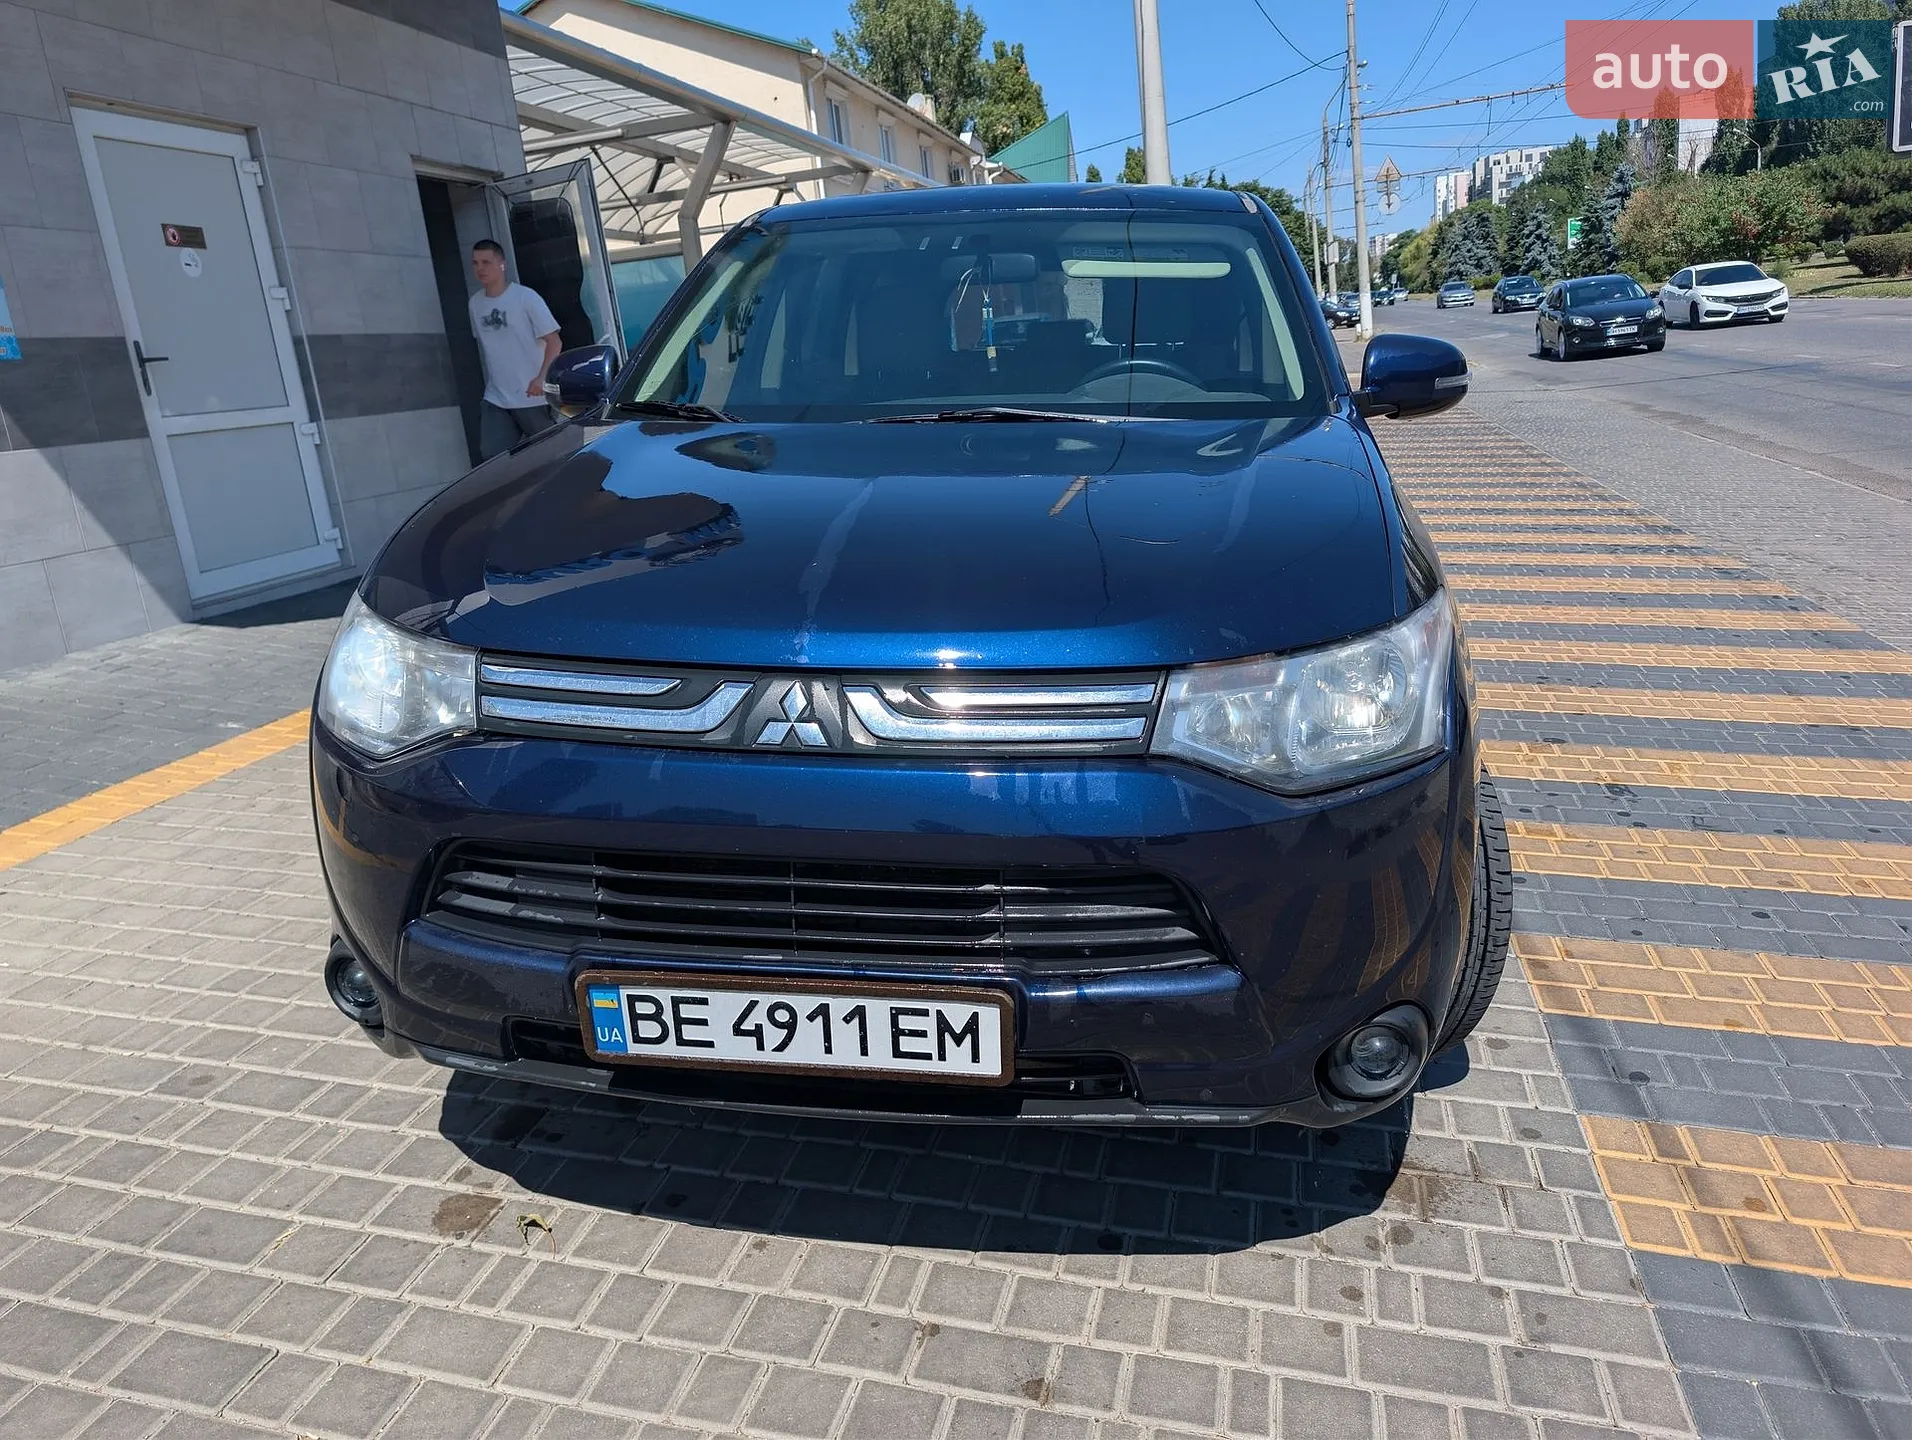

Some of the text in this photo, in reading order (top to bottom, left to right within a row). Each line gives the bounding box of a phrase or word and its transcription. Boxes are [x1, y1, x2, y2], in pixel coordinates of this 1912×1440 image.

[597, 1027, 623, 1043] UA
[626, 993, 980, 1064] BE 4911 EM
